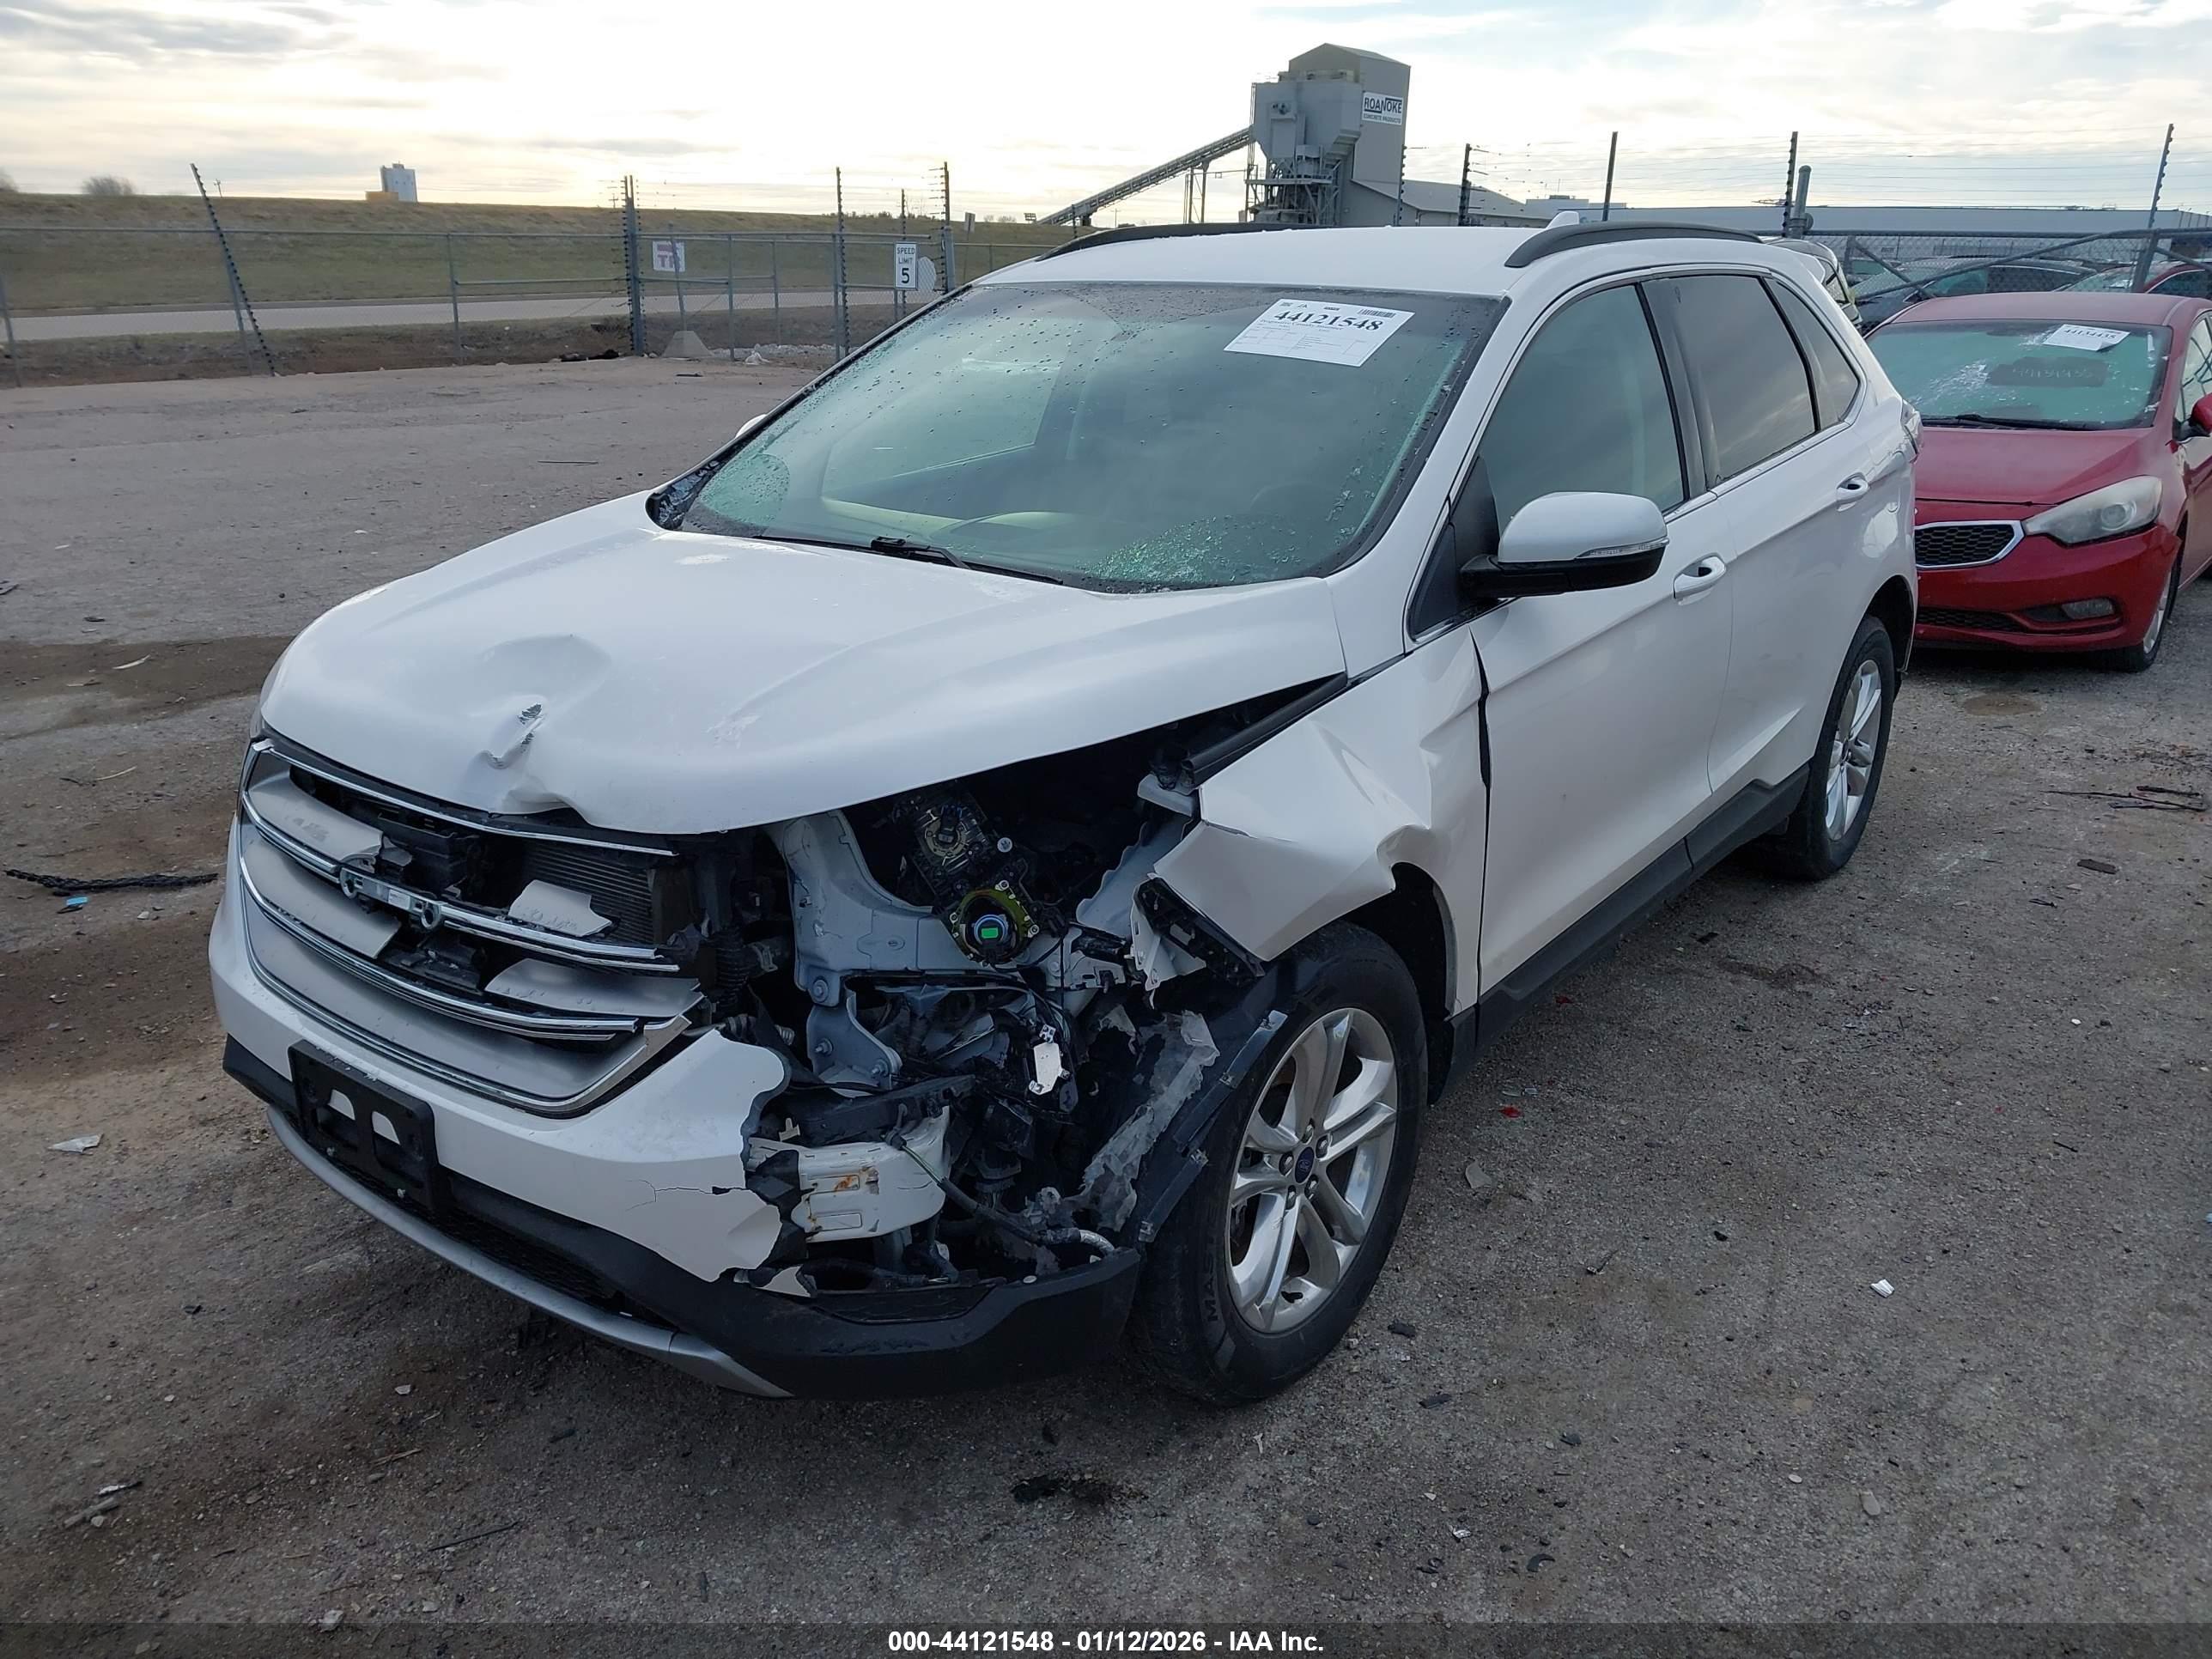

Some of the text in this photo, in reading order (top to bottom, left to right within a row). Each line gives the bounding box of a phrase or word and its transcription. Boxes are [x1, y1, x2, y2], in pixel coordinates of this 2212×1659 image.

[1364, 97, 1402, 114] ROANOKE
[896, 246, 915, 255] SPEED
[902, 267, 910, 284] 5
[1273, 310, 1383, 331] 44121548
